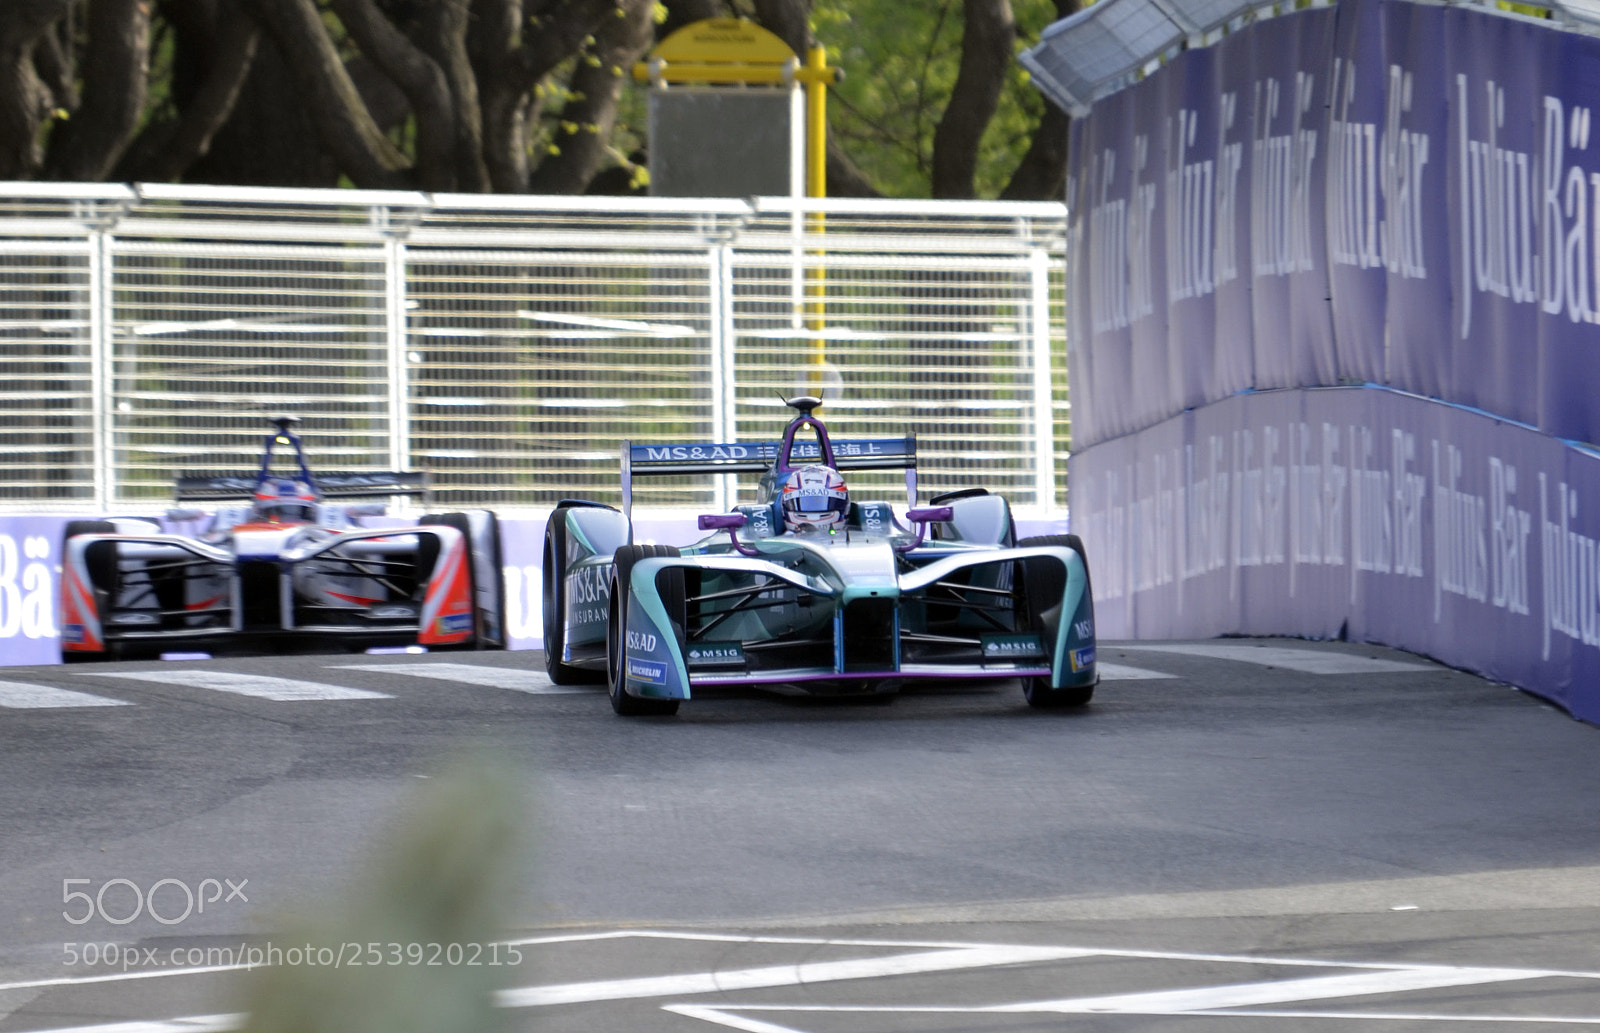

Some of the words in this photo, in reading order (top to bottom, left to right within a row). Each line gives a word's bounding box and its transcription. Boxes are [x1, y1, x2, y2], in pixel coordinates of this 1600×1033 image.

[646, 446, 748, 461] MS&AD
[1538, 471, 1600, 662] Juliu
[0, 533, 61, 639] Bä
[572, 607, 608, 624] INSURAN
[702, 649, 738, 658] MSIG
[1000, 643, 1036, 651] MSIG
